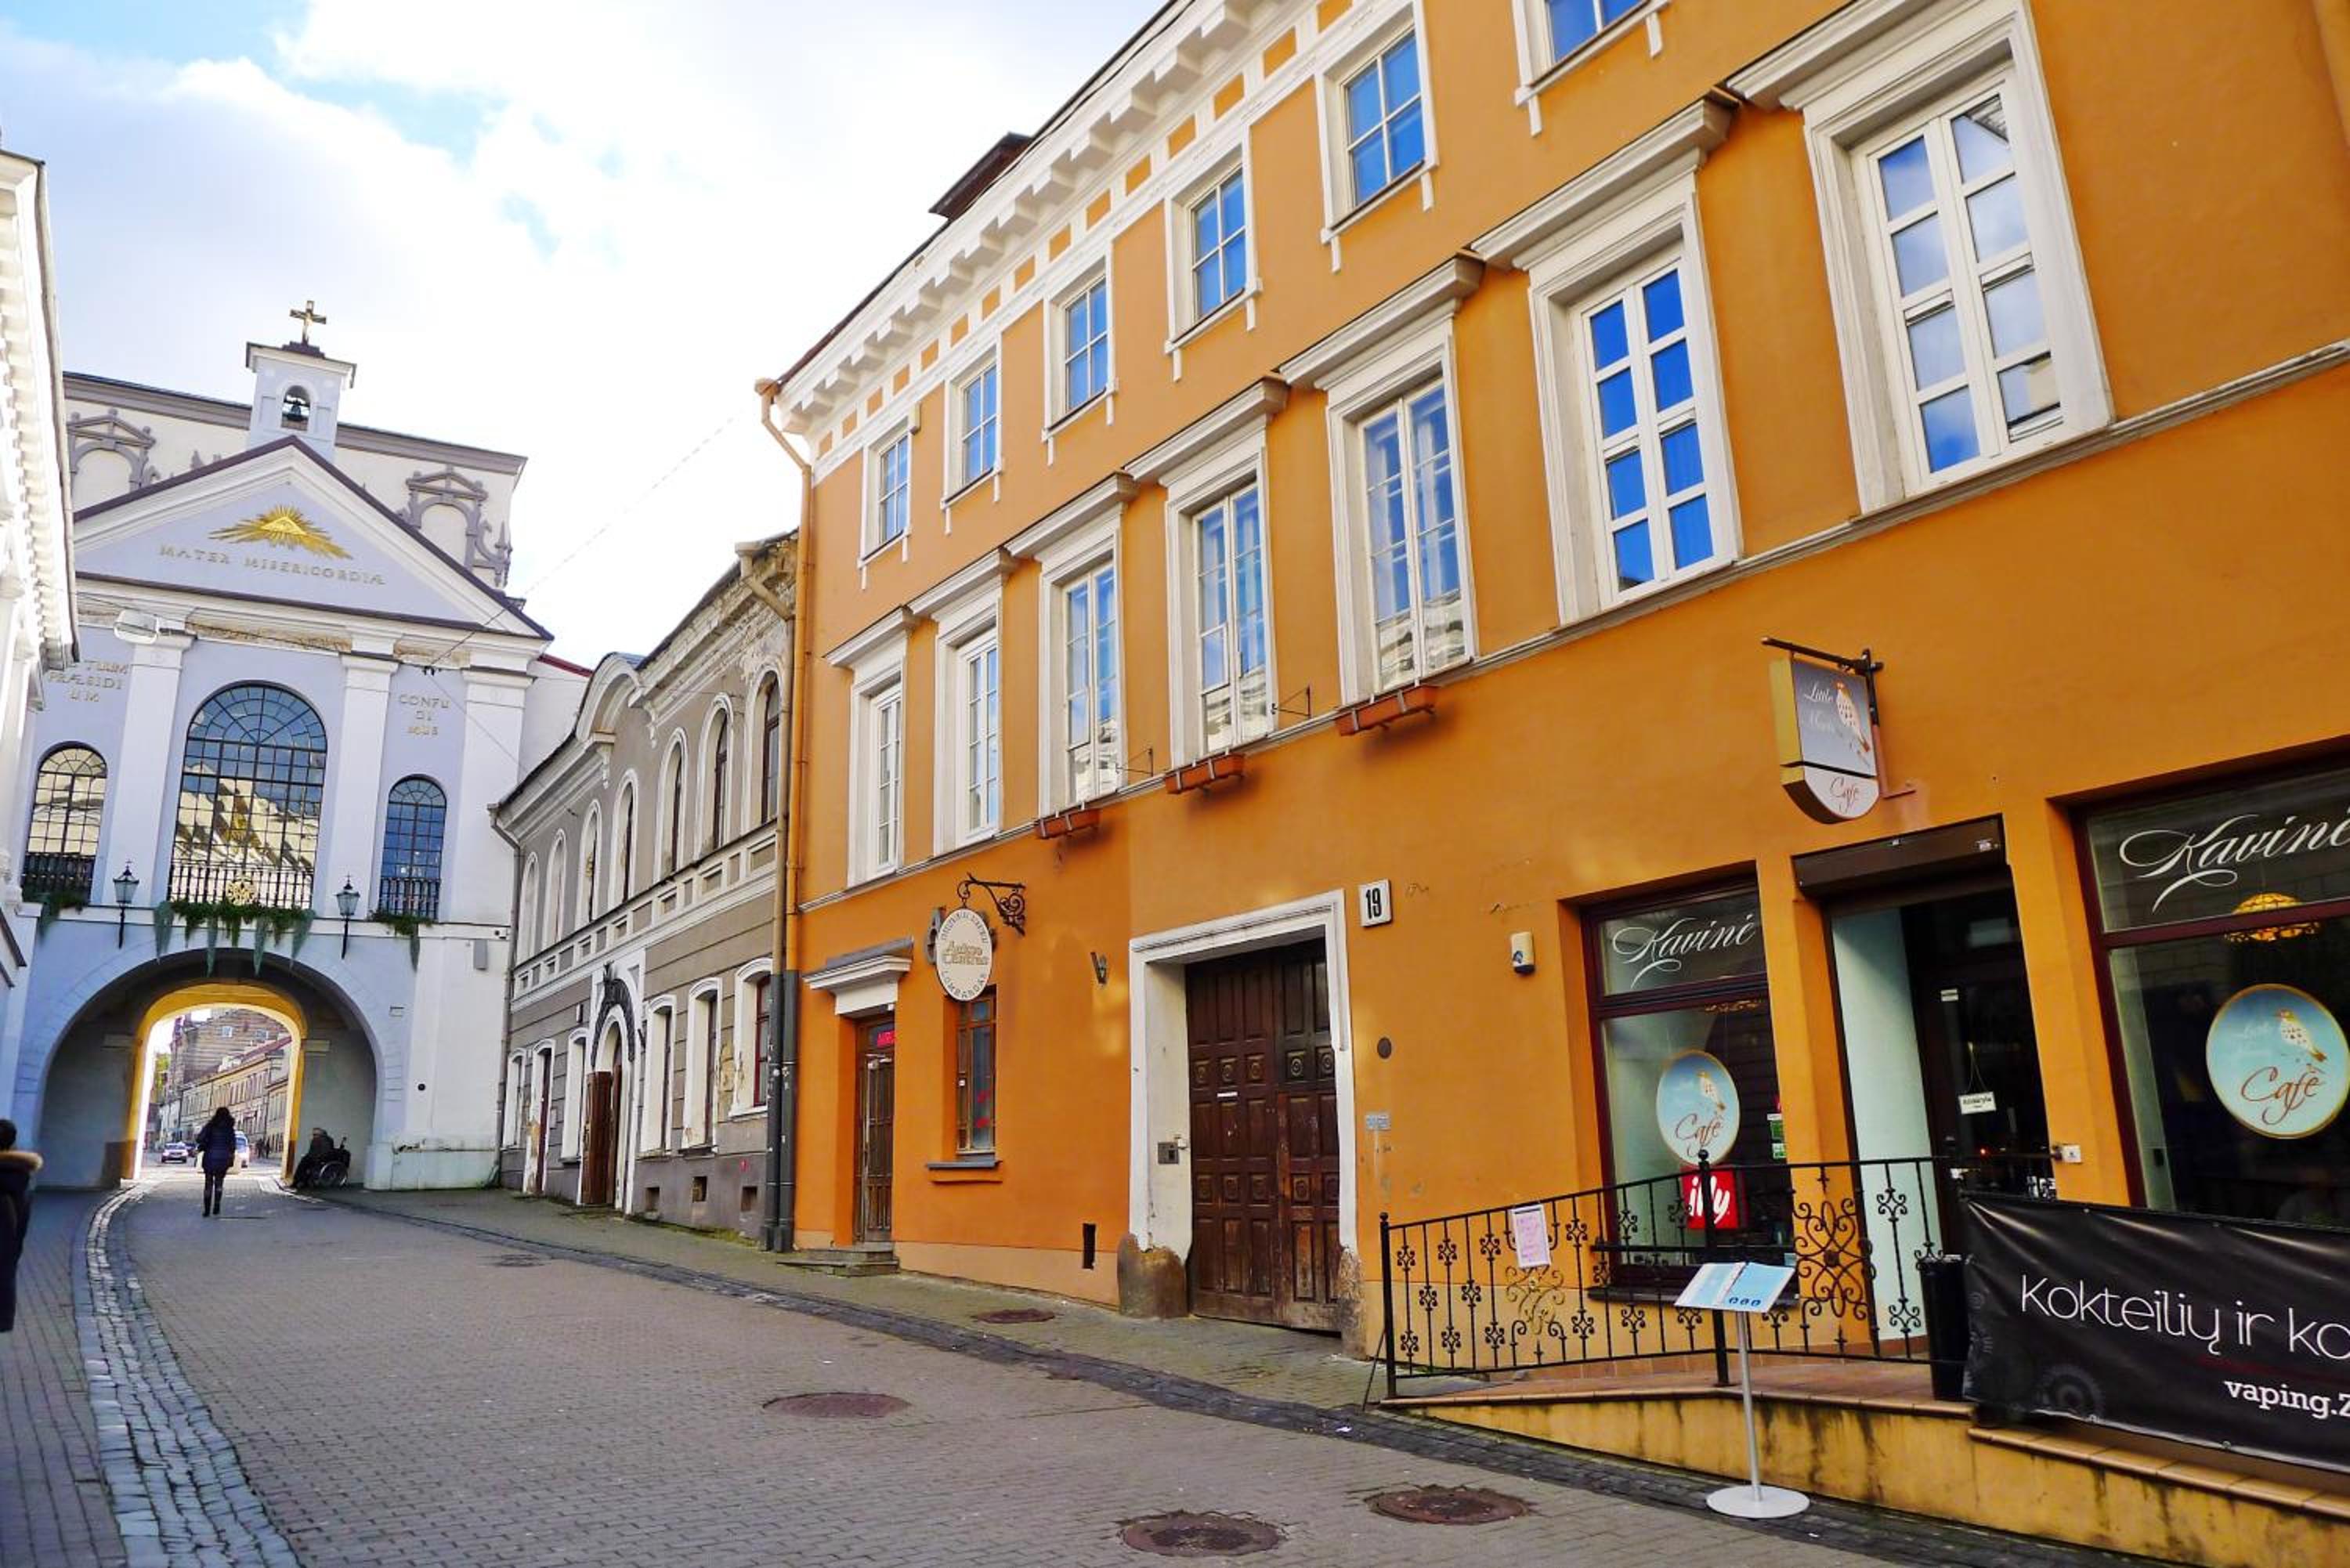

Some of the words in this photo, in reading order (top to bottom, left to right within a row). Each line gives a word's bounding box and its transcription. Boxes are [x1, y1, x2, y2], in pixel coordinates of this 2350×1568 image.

[160, 545, 230, 565] MATER
[1365, 887, 1382, 919] 19
[2021, 1274, 2222, 1356] Kokteilių
[2236, 1300, 2276, 1346] ir
[2222, 1379, 2350, 1419] vaping.Z
